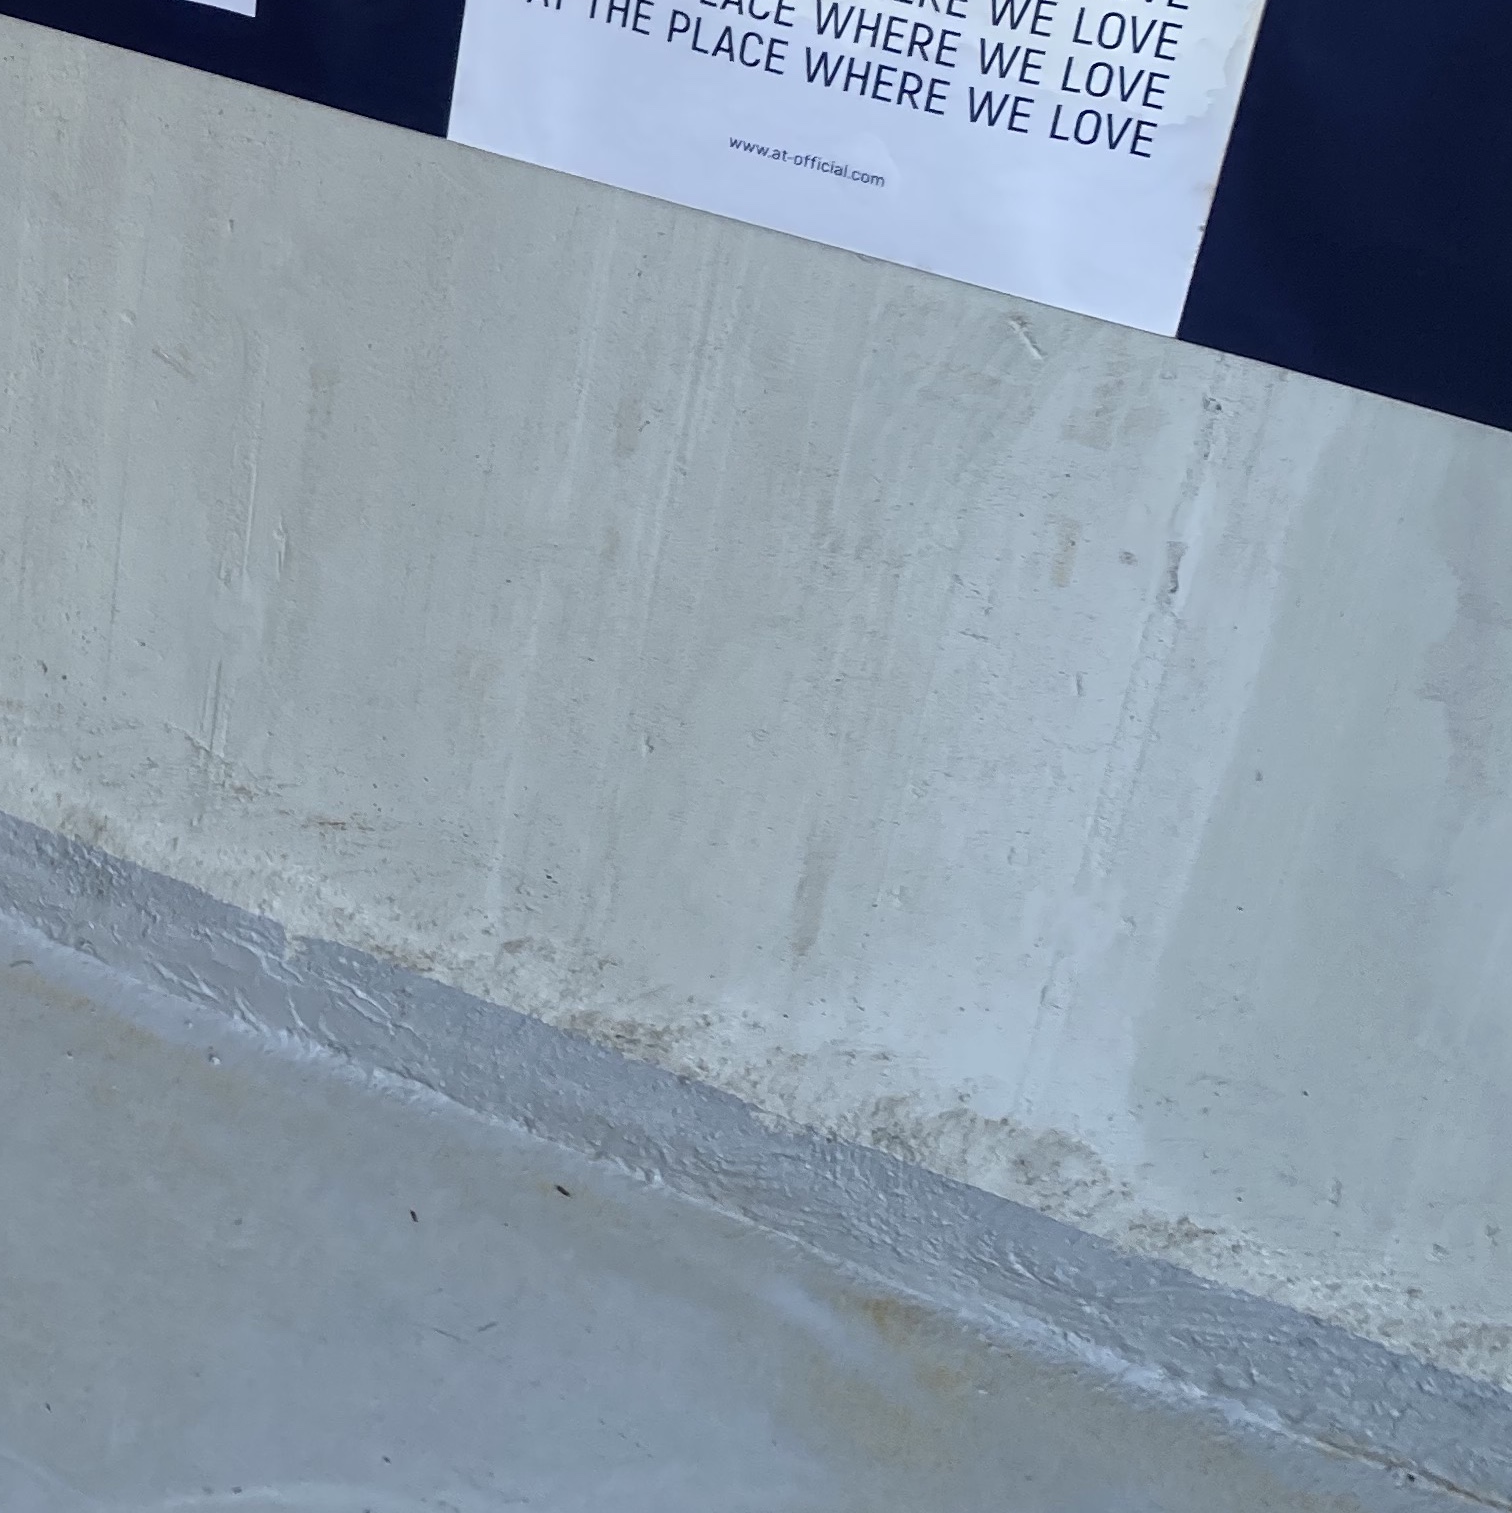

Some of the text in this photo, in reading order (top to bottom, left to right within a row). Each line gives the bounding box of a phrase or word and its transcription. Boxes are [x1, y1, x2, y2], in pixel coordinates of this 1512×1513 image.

[666, 8, 790, 76] PLACE
[804, 45, 951, 116] WHERE
[968, 85, 1036, 134] WE
[1048, 103, 1159, 159] LOVE
[979, 37, 1047, 86] WE
[1059, 55, 1171, 111] LOVE
[728, 136, 886, 188] www.at-official.com
